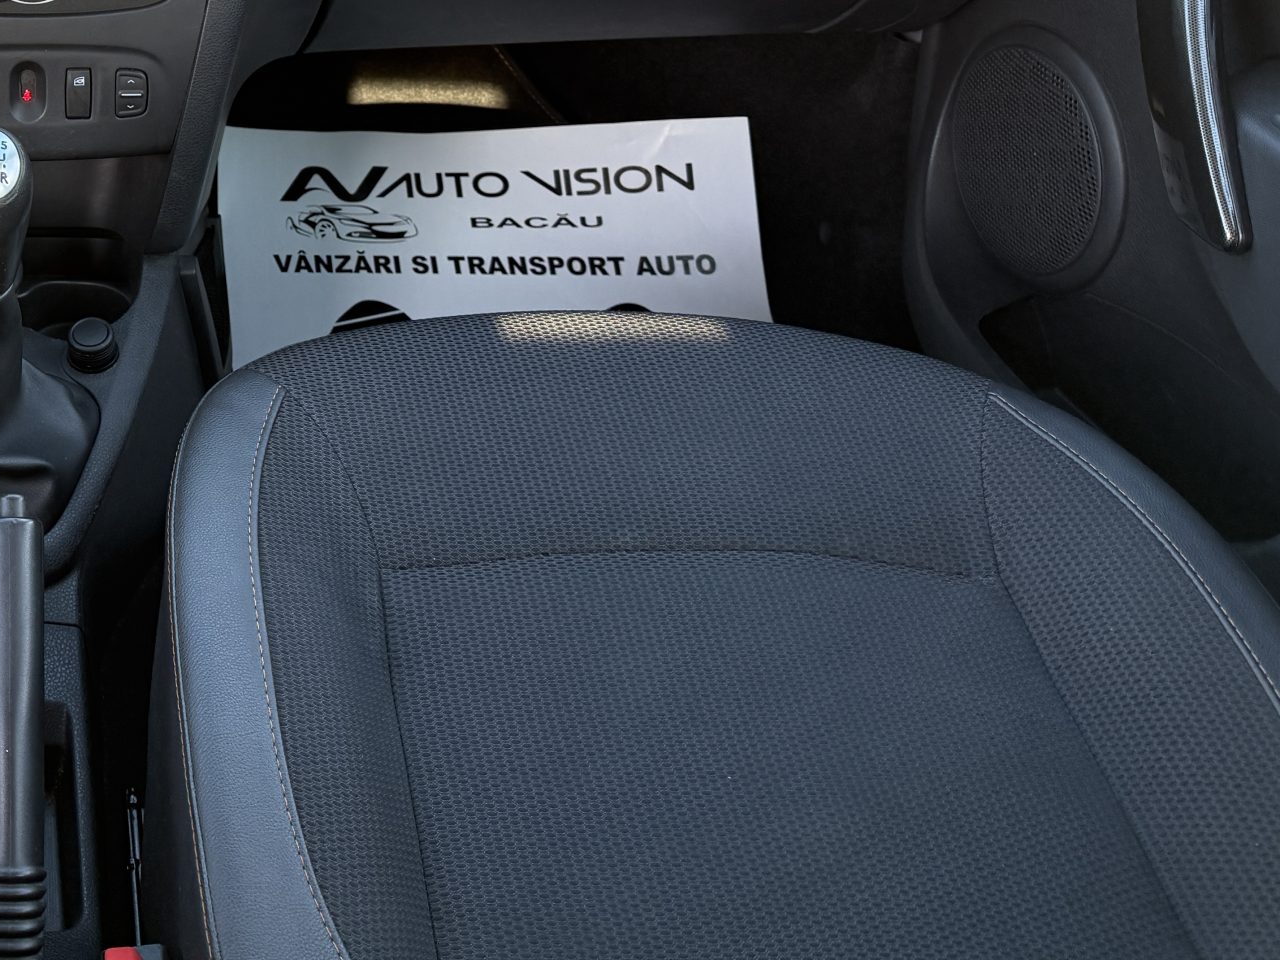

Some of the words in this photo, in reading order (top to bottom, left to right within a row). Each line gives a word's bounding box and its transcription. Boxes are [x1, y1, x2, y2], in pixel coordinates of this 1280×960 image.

[0, 140, 8, 150] 5
[0, 171, 9, 185] R
[375, 171, 510, 198] AUTO
[520, 162, 695, 197] VISION
[469, 212, 603, 229] BACĂU
[272, 249, 402, 275] VÂNZĂRI
[411, 255, 439, 275] SI
[447, 255, 624, 277] TRANSPORT
[636, 253, 716, 277] AUTO
